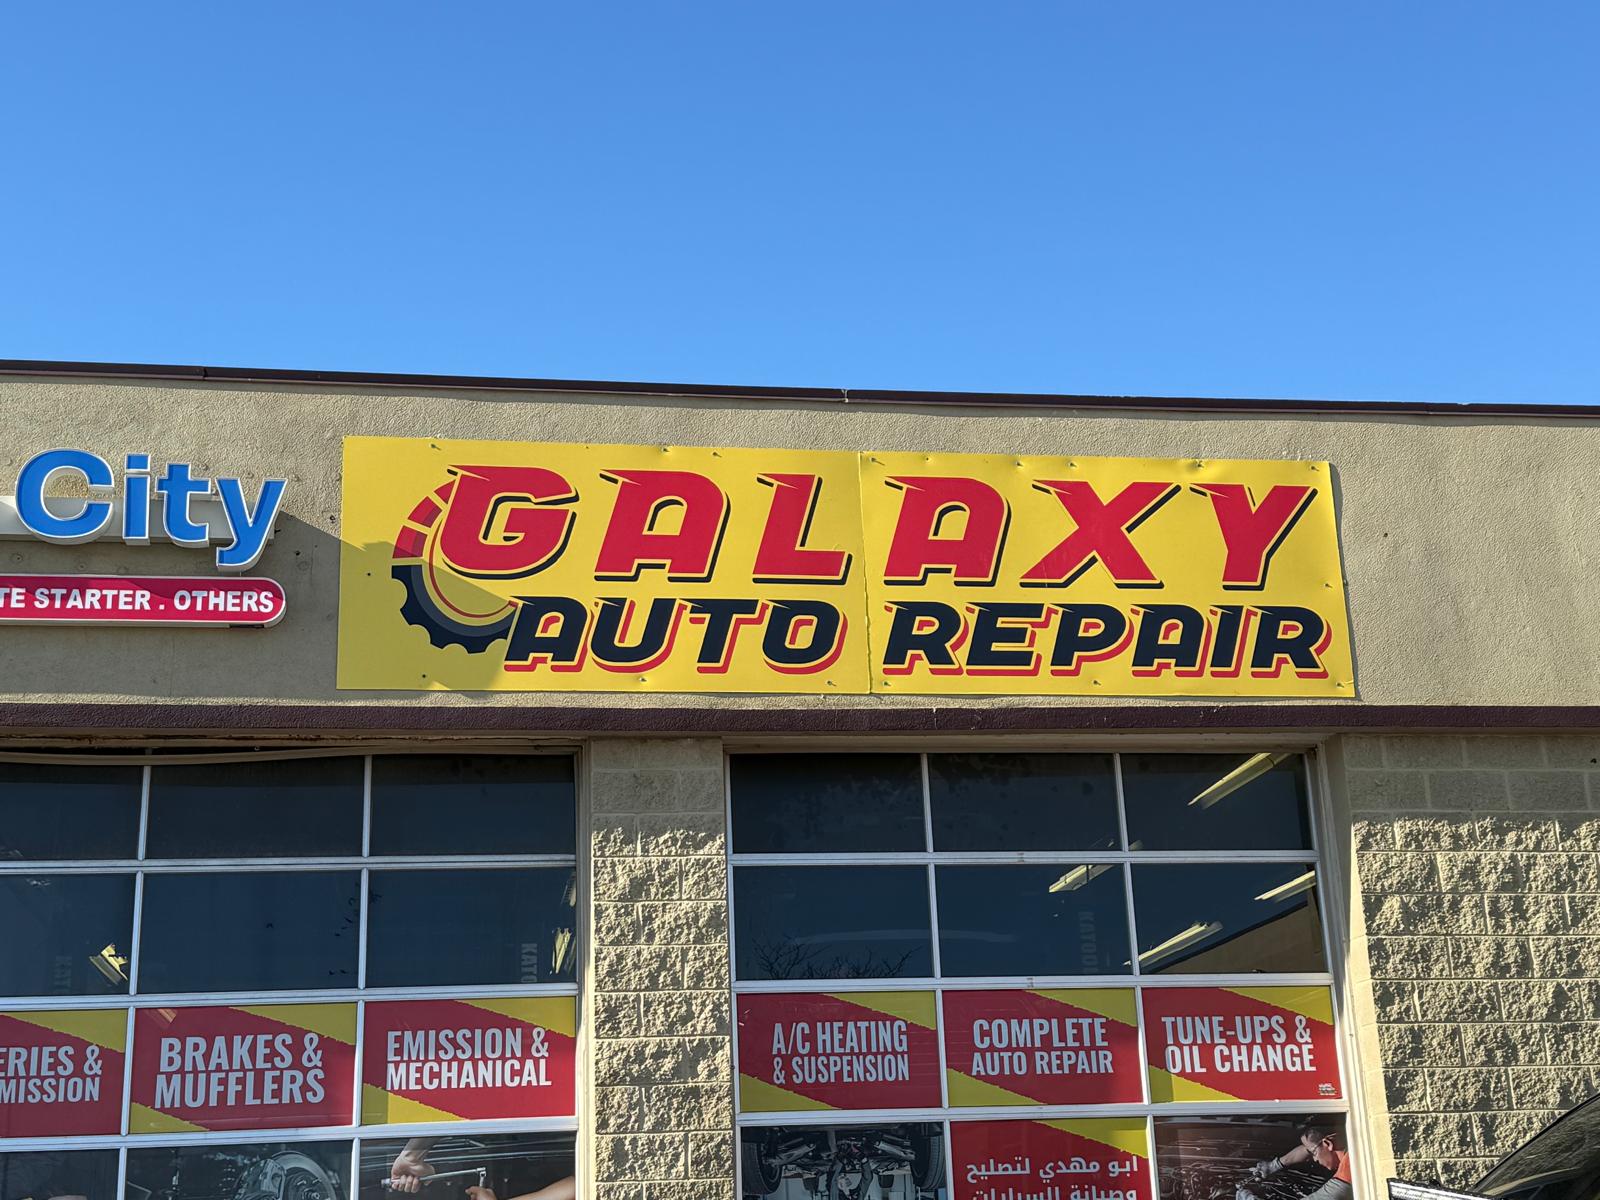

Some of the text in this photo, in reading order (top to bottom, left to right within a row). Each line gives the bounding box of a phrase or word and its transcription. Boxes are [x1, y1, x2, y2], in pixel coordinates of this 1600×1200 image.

[16, 448, 288, 572] City
[440, 464, 1318, 591] GALAXY
[34, 588, 151, 611] STARTER
[174, 590, 274, 613] OTHERS
[503, 595, 1332, 678] AUTO REPAIR
[387, 1027, 549, 1062] EMISSION &
[772, 1020, 908, 1055] A/C HEATING
[973, 1018, 1109, 1049] COMPLETE
[1161, 1015, 1312, 1045] TUNE-UPS &
[83, 1045, 102, 1076] &
[159, 1032, 322, 1072] BRAKES &
[971, 1050, 1114, 1076] AUTO REPAIR
[1165, 1044, 1316, 1074] OIL CHANGE
[386, 1058, 552, 1091] MECHANICAL
[773, 1054, 909, 1085] & SUSPENSION
[154, 1068, 325, 1109] MUFFLERS
[966, 1155, 1138, 1184] ابو مهدي لتصليح
